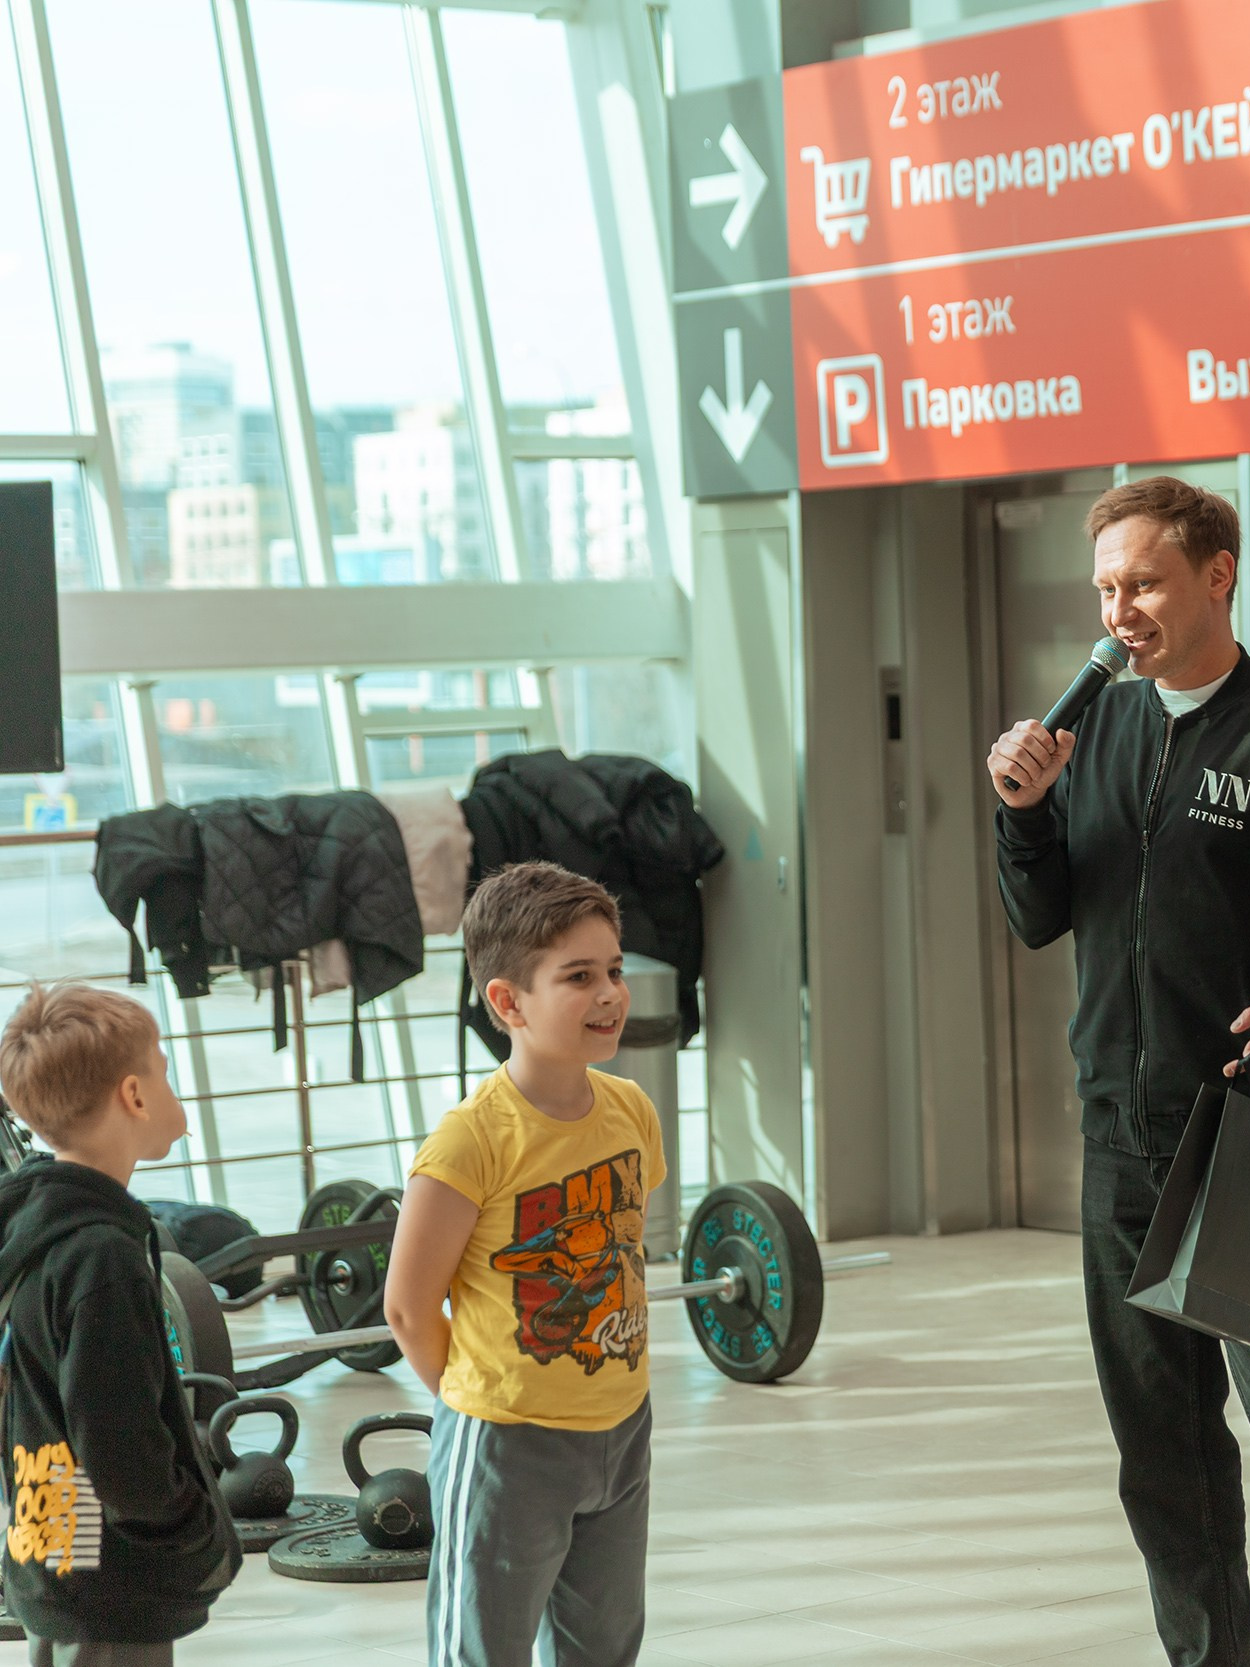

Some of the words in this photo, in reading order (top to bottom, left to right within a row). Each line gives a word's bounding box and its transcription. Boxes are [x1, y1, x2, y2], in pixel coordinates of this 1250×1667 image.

[888, 75, 907, 129] 2
[916, 71, 1003, 125] этаж
[888, 131, 1135, 208] Гипермаркет
[899, 295, 914, 345] 1
[927, 295, 1016, 344] этаж
[901, 374, 1082, 437] Парковка
[1187, 807, 1245, 831] FITNESS
